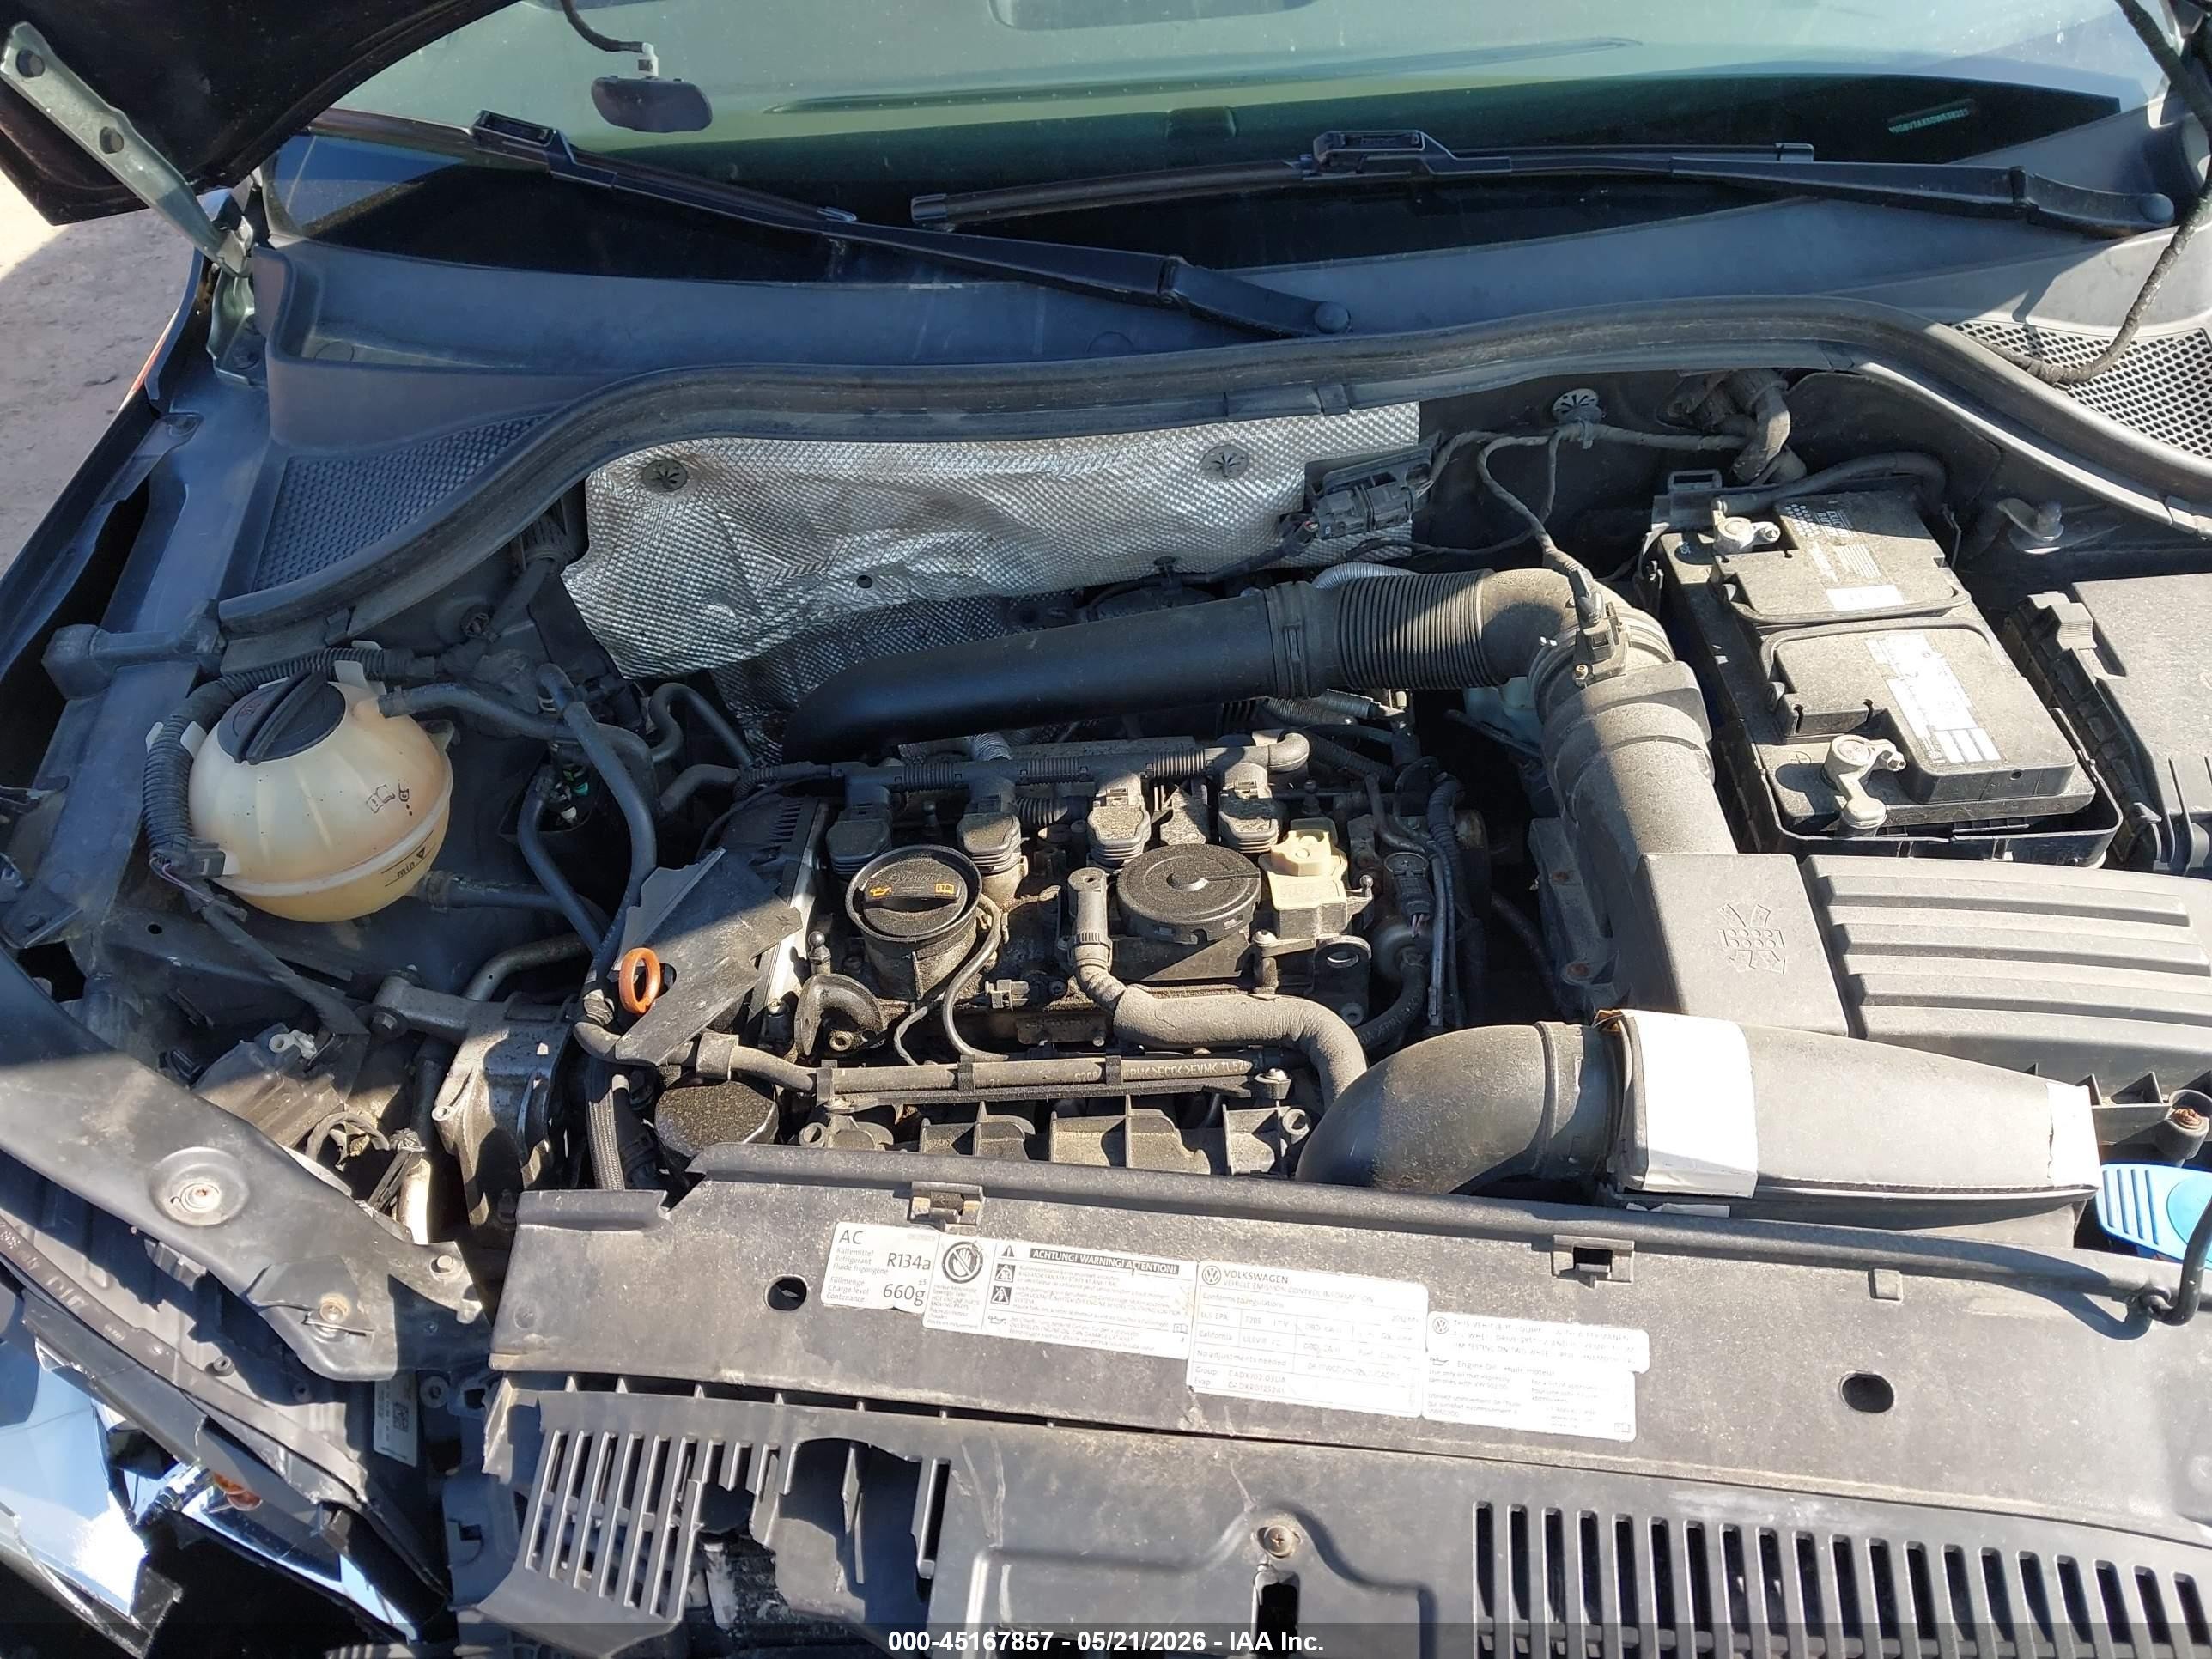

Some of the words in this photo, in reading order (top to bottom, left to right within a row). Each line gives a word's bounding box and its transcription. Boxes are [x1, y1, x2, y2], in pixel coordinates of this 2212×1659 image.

[838, 1229, 864, 1245] AC
[886, 1252, 932, 1271] R134a
[1032, 1249, 1079, 1263] ACHTUNG!
[1079, 1254, 1124, 1268] WARNING!
[1125, 1261, 1177, 1274] ATTENTION!
[1224, 1268, 1290, 1285] VOLKSWAGEN
[828, 1285, 852, 1294] Charge
[854, 1285, 870, 1295] level
[1224, 1280, 1251, 1290] VEHICLE
[883, 1283, 927, 1307] 660g
[1198, 1329, 1233, 1341] California
[1197, 1349, 1207, 1358] No
[1258, 1357, 1287, 1366] needed
[1457, 1359, 1483, 1370] Engine
